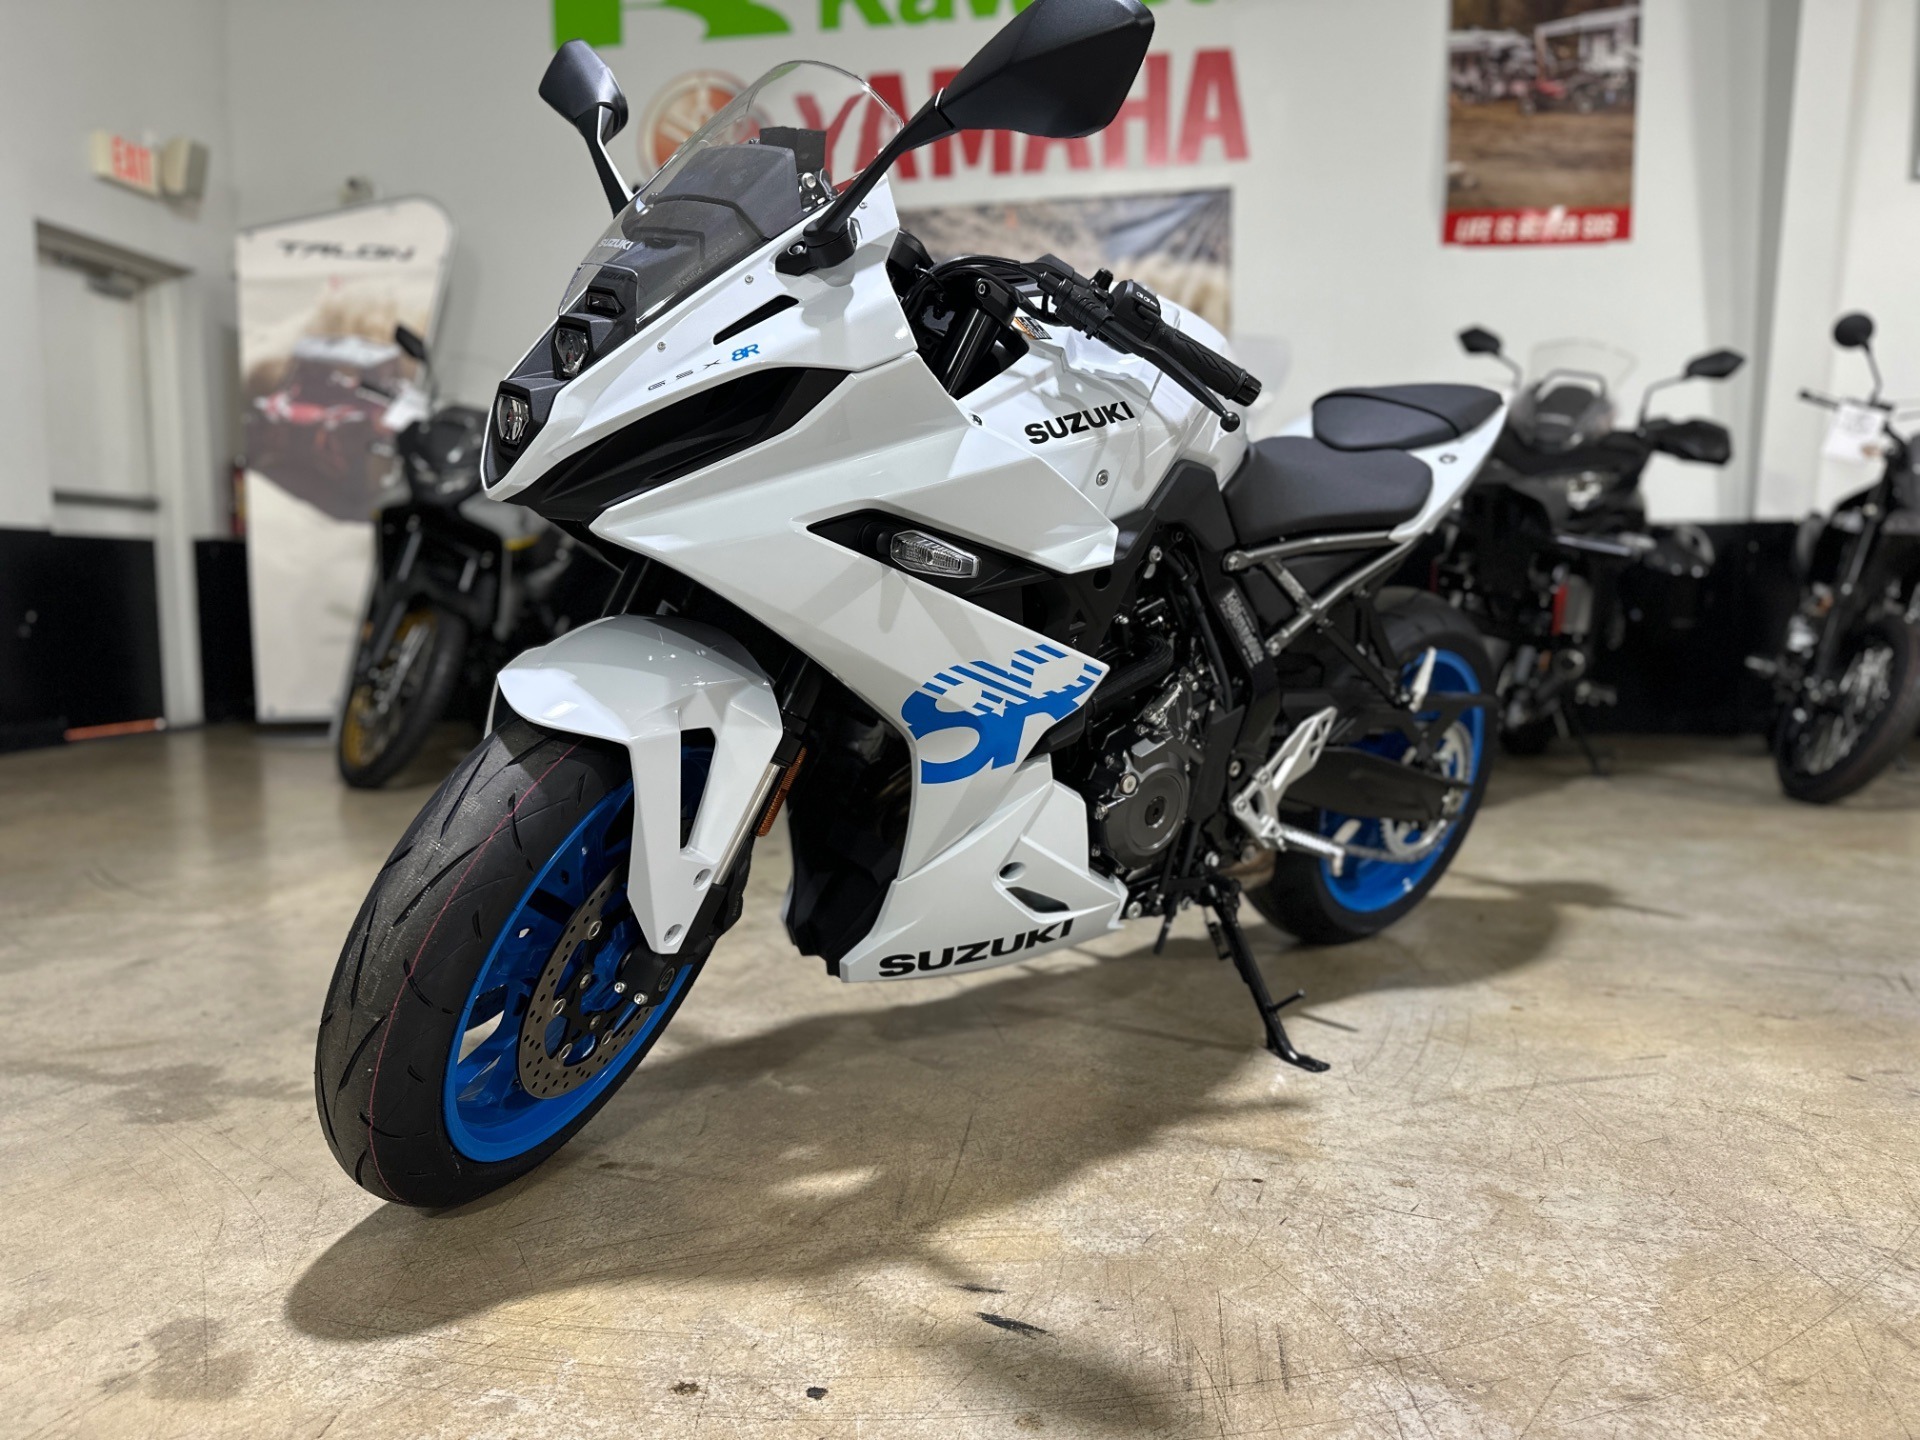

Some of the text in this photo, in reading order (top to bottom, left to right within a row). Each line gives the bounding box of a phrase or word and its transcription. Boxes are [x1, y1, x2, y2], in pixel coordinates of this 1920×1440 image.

[112, 137, 151, 186] EXIT
[277, 240, 416, 263] TALON
[598, 238, 634, 250] SUZUKI
[731, 344, 760, 361] 8R
[1024, 401, 1135, 444] SUZUKI
[878, 918, 1074, 977] SUZUKI
